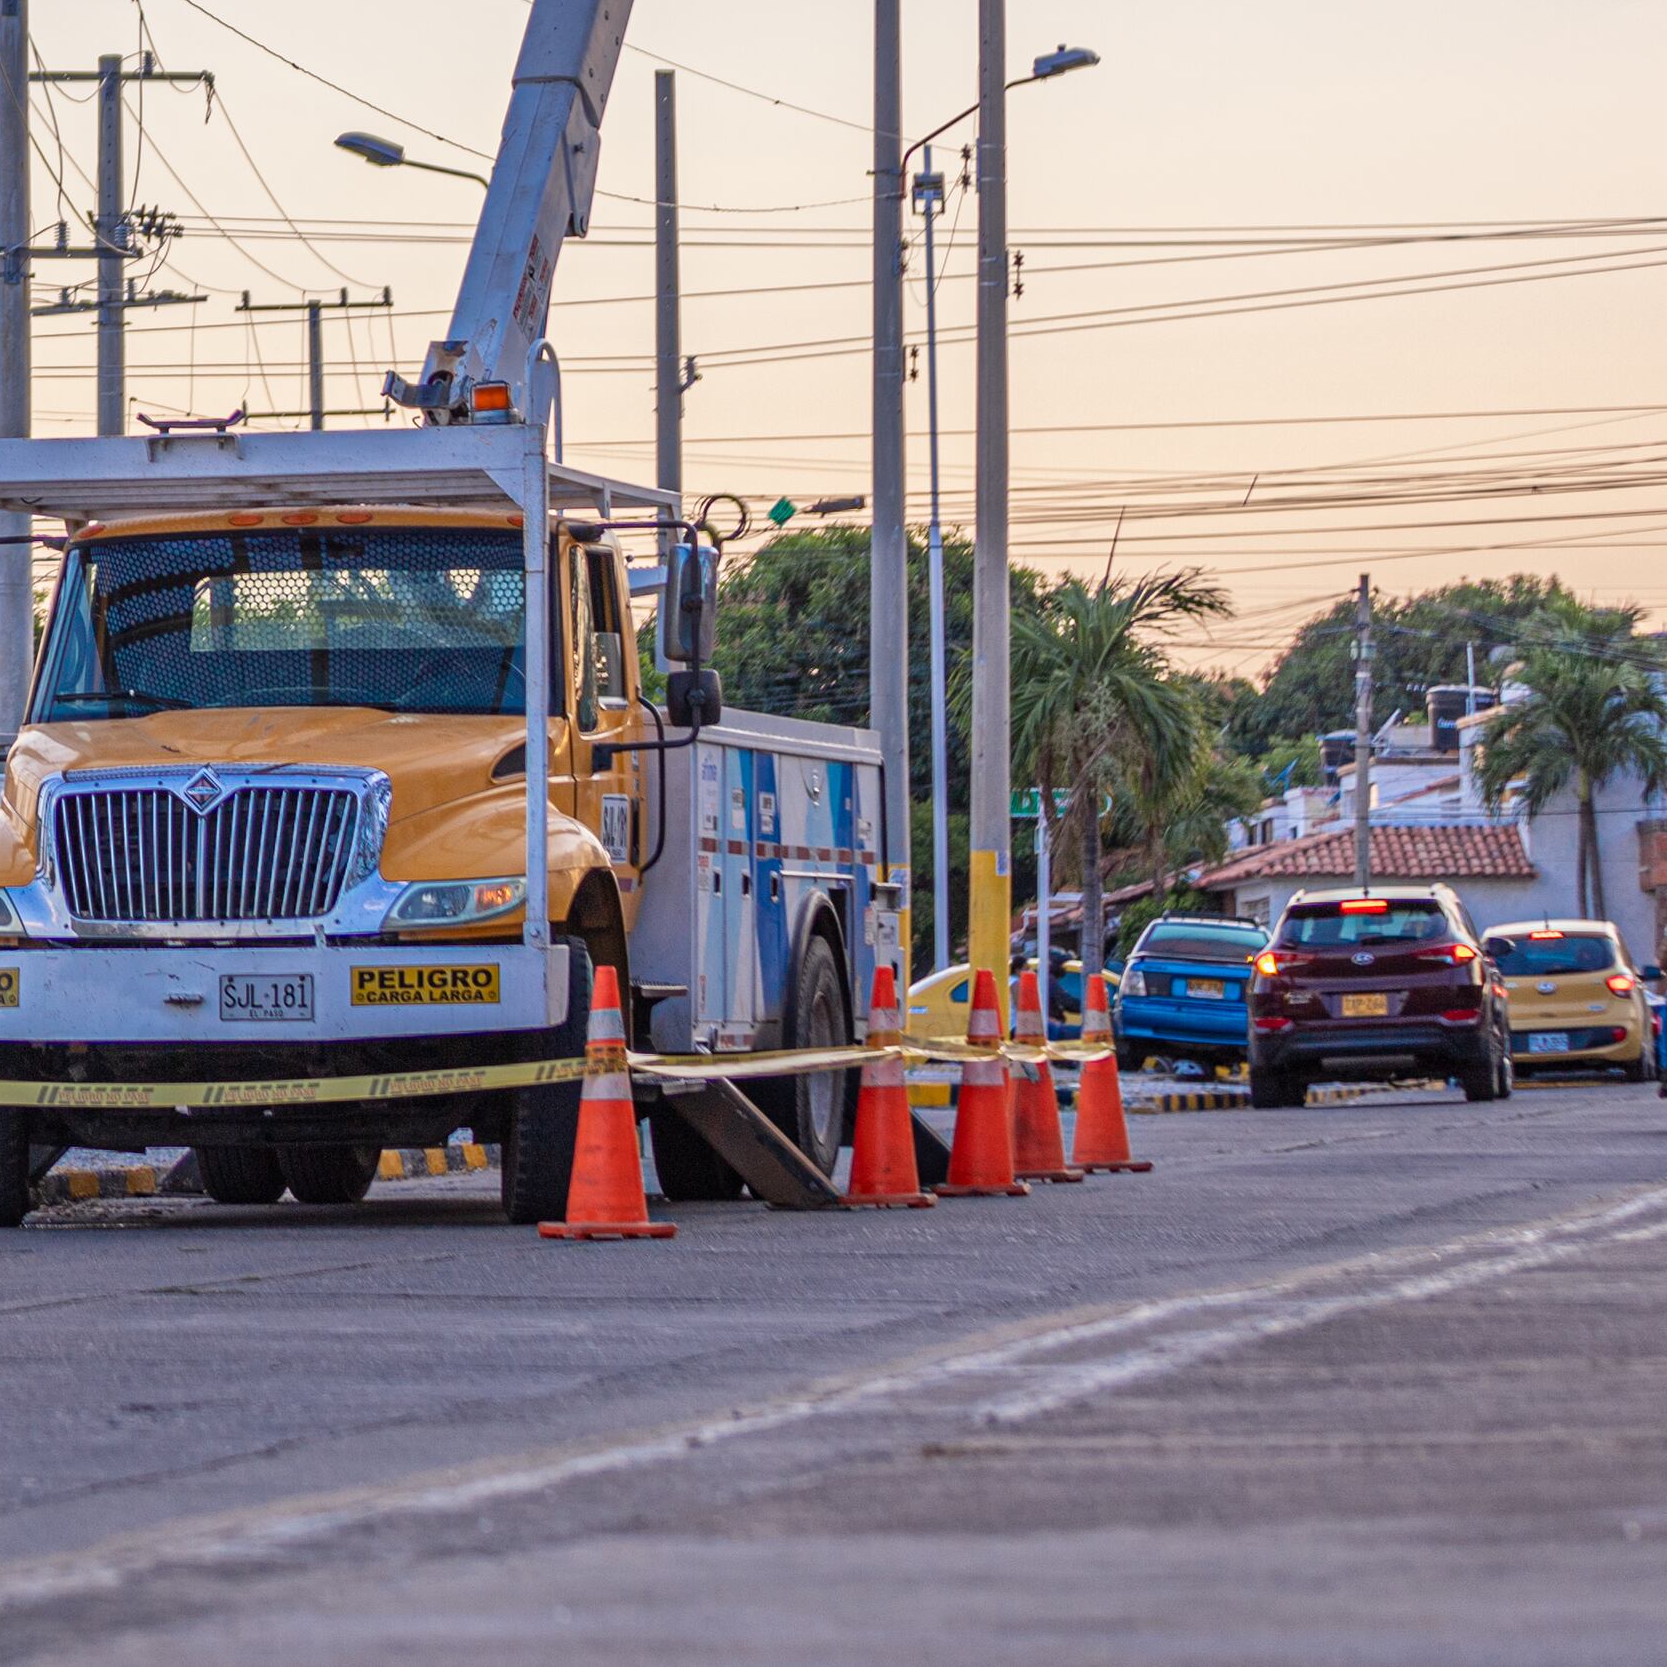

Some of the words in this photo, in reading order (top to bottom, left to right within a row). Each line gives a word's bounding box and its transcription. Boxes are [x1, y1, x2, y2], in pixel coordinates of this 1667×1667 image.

[358, 968, 493, 989] PELIGRO
[366, 990, 424, 1003] CARGA
[429, 989, 484, 1002] LARGA
[249, 1009, 259, 1017] EL
[263, 1009, 284, 1017] PASO
